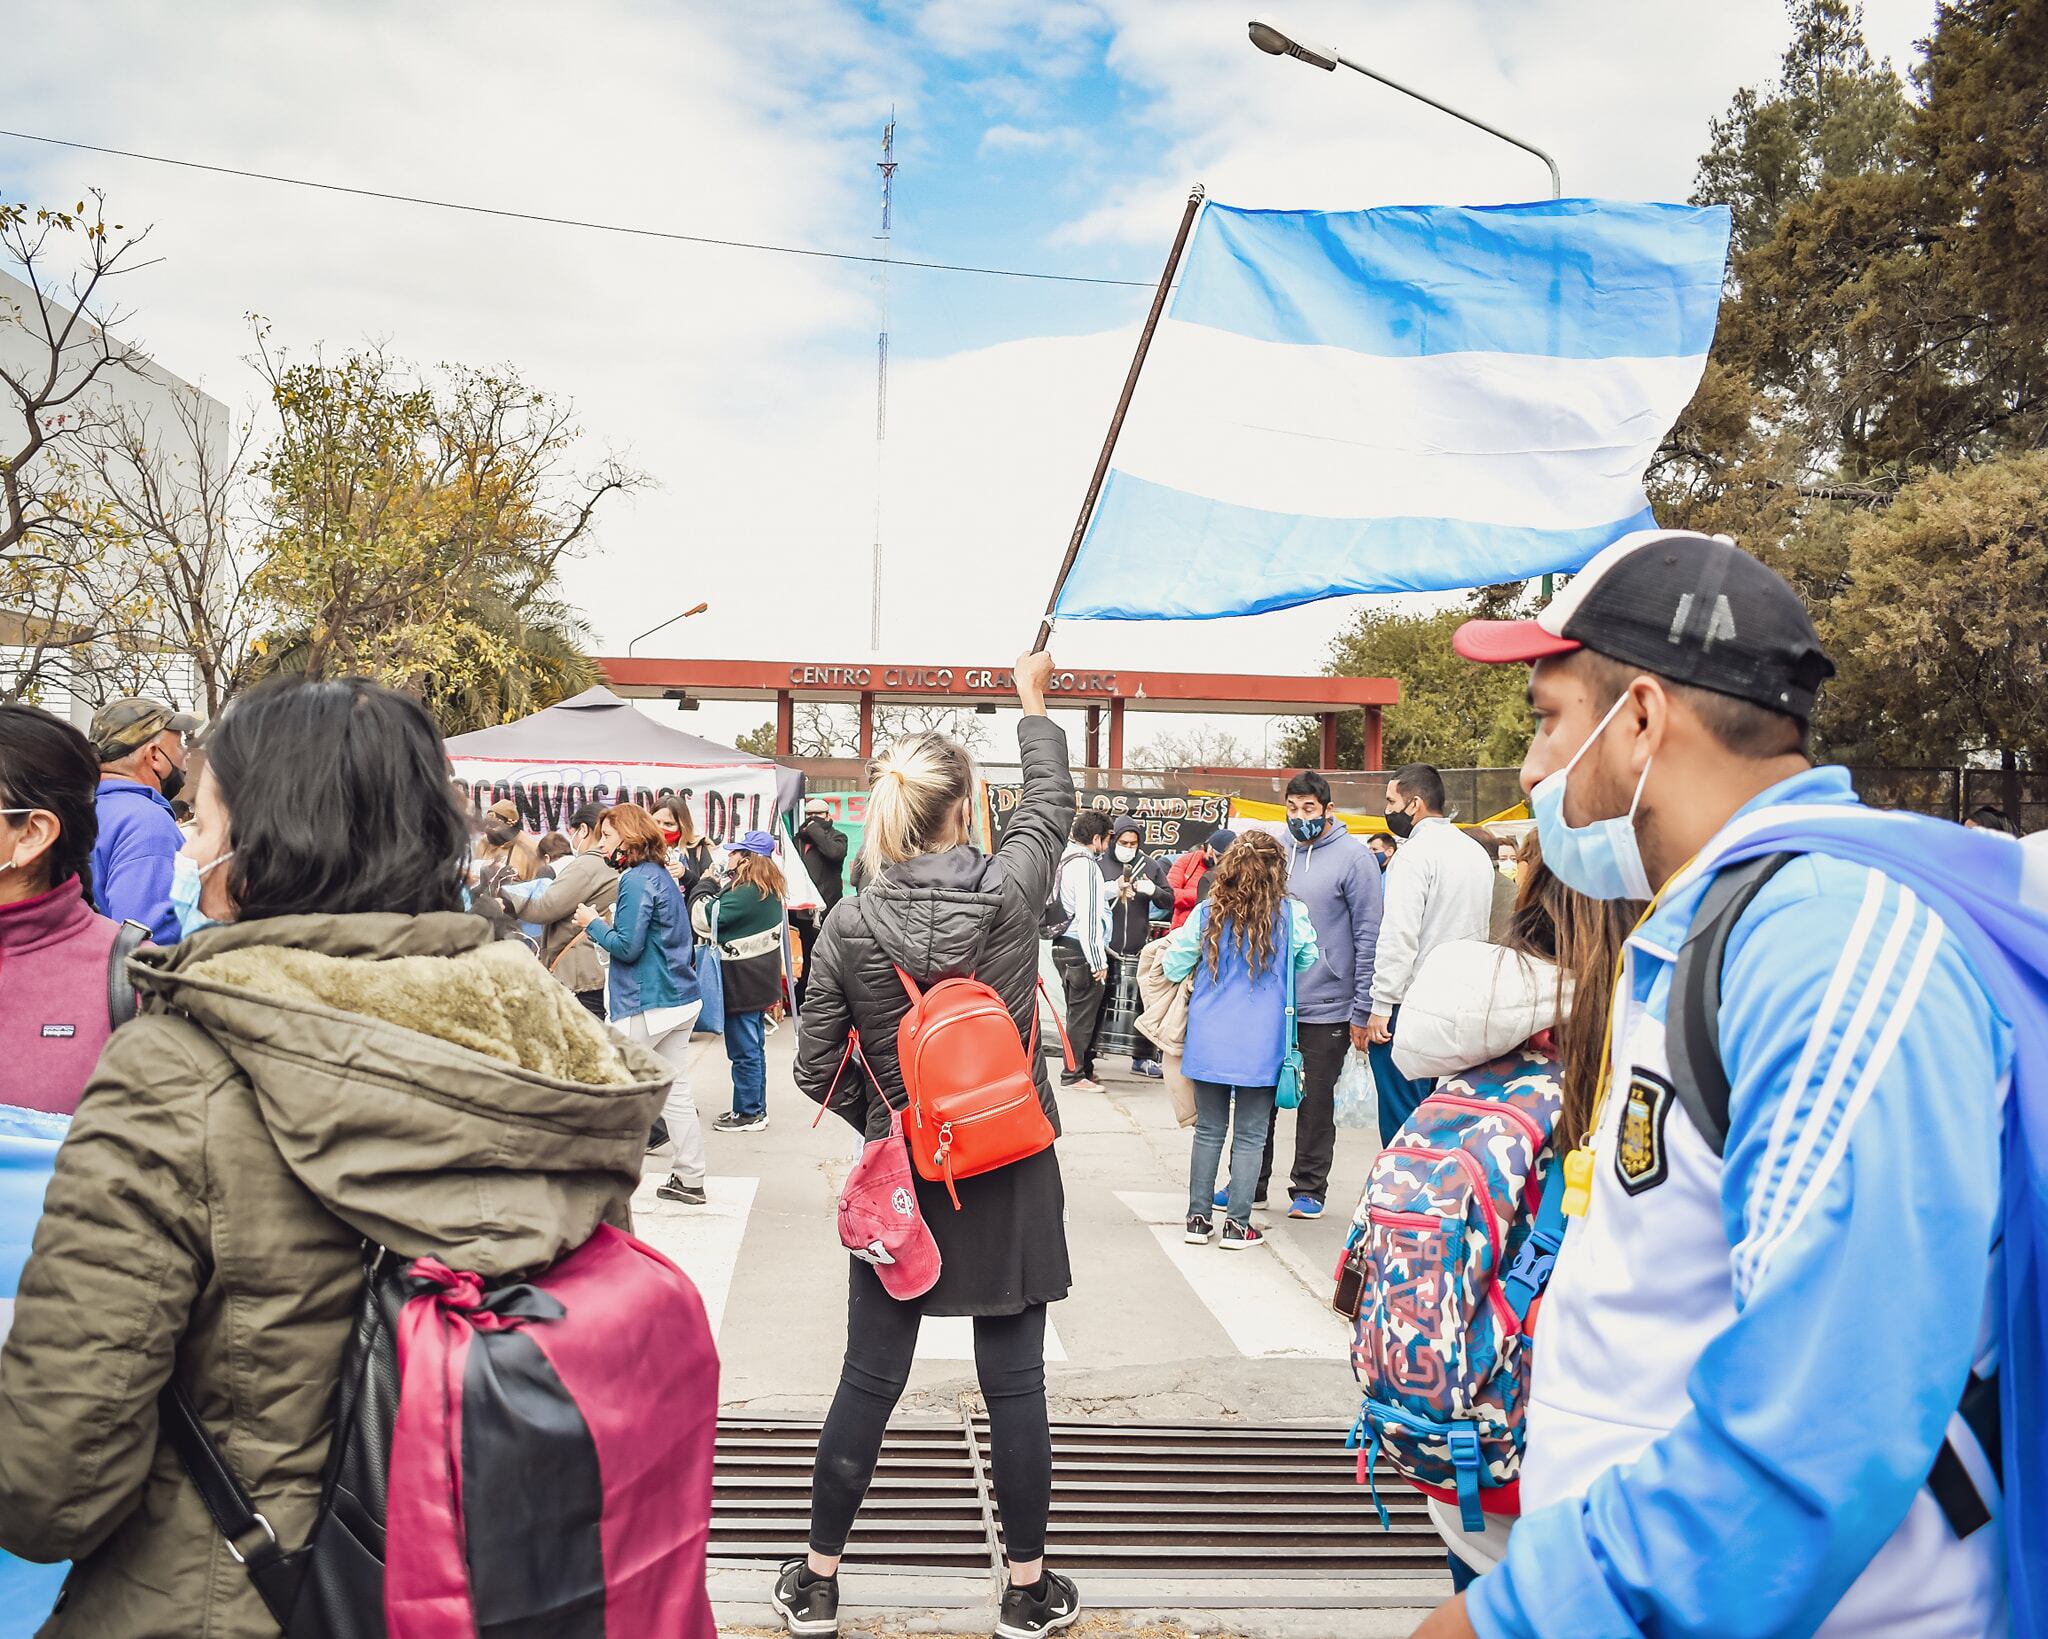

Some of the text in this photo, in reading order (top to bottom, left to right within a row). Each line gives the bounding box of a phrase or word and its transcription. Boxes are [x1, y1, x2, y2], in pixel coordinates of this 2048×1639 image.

[790, 666, 871, 686] CENTRO
[883, 668, 953, 688] CIVICO
[964, 669, 1017, 688] GRAN
[1075, 790, 1130, 816] LOS
[1132, 797, 1220, 823] ANDES
